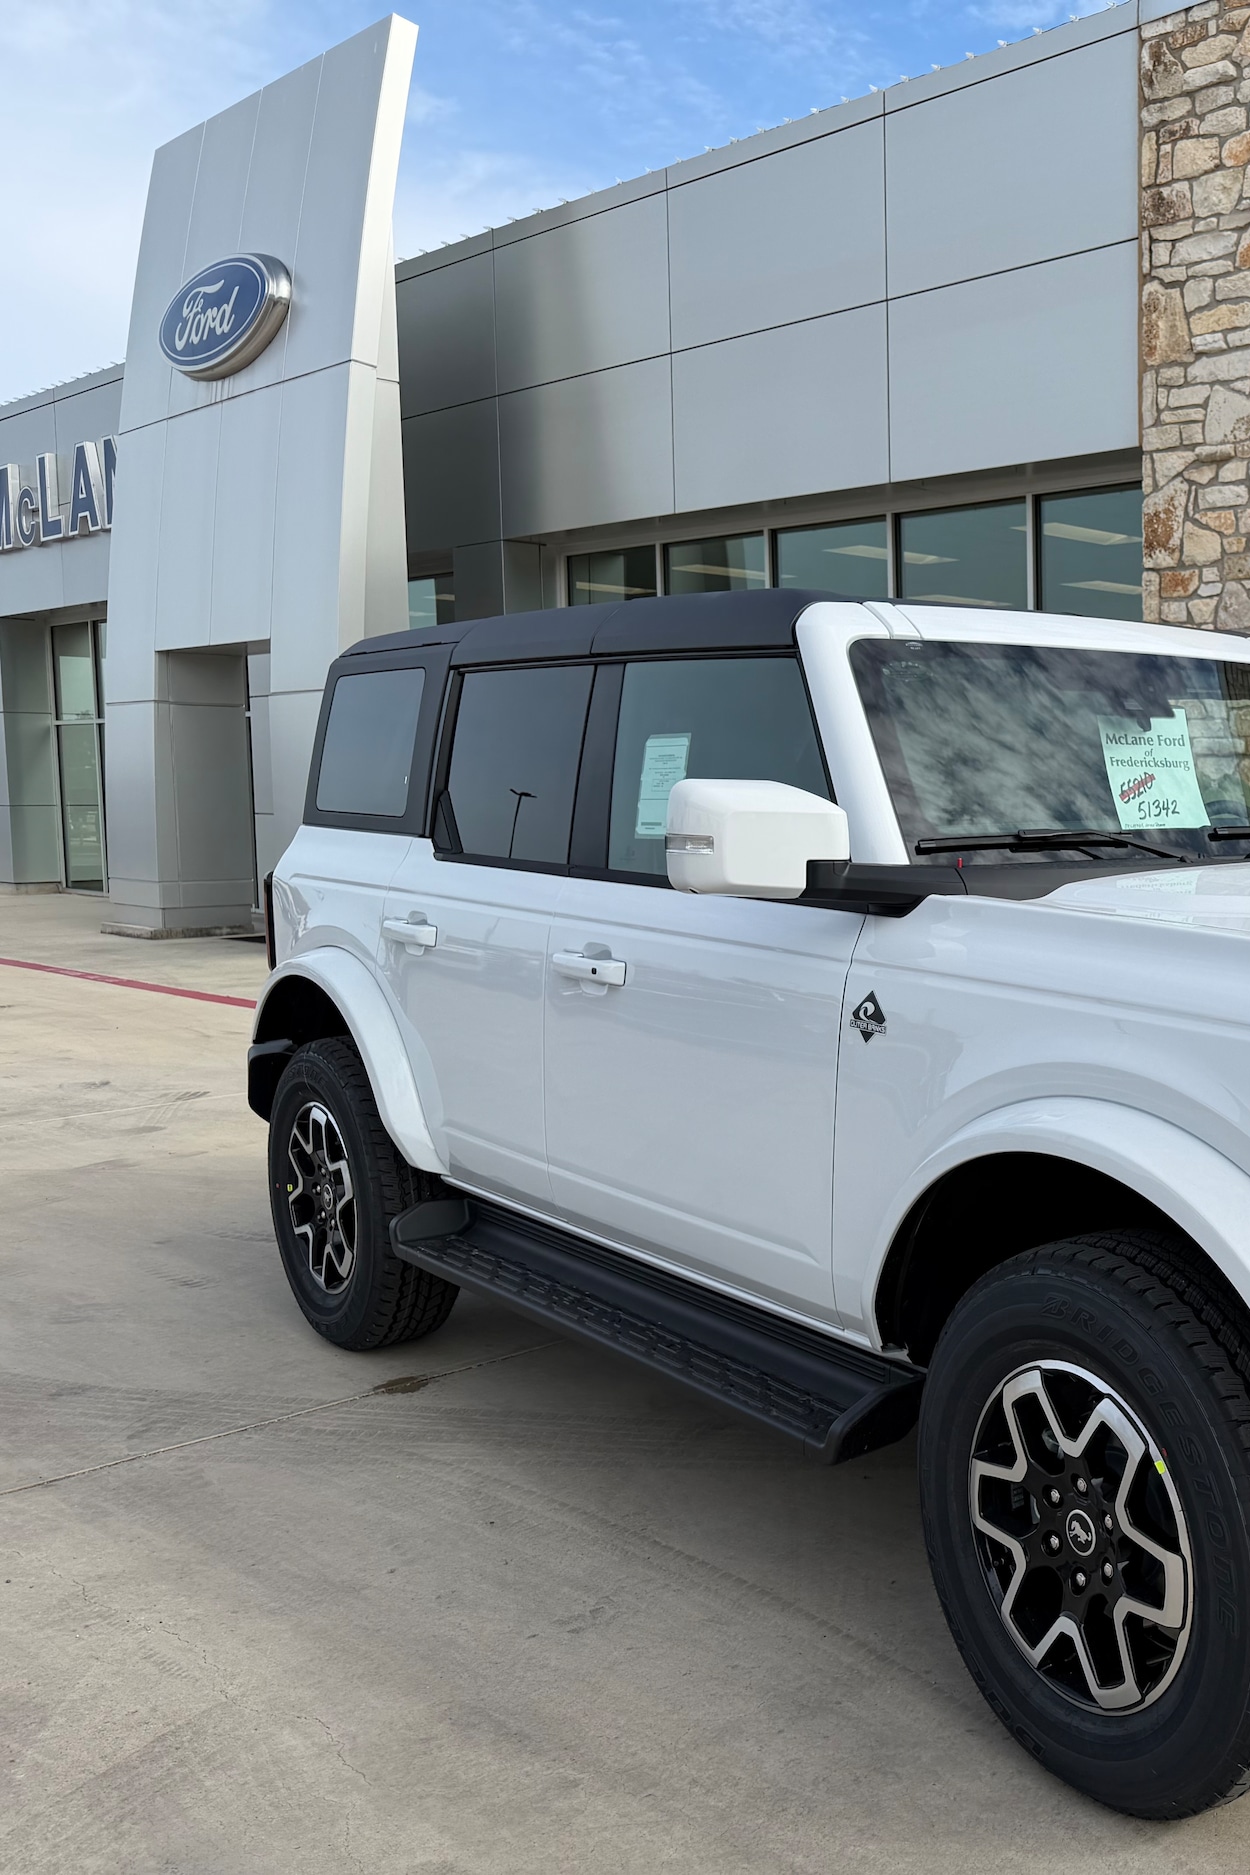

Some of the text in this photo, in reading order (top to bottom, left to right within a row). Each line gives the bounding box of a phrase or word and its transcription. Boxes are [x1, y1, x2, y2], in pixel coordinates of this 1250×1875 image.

[174, 280, 240, 351] Ford
[1105, 733, 1186, 747] McLane Ford
[1144, 748, 1154, 757] of
[1109, 756, 1190, 771] Fredericksburg
[1138, 798, 1180, 820] 51342
[1039, 1292, 1240, 1640] BRIDGESTONE
